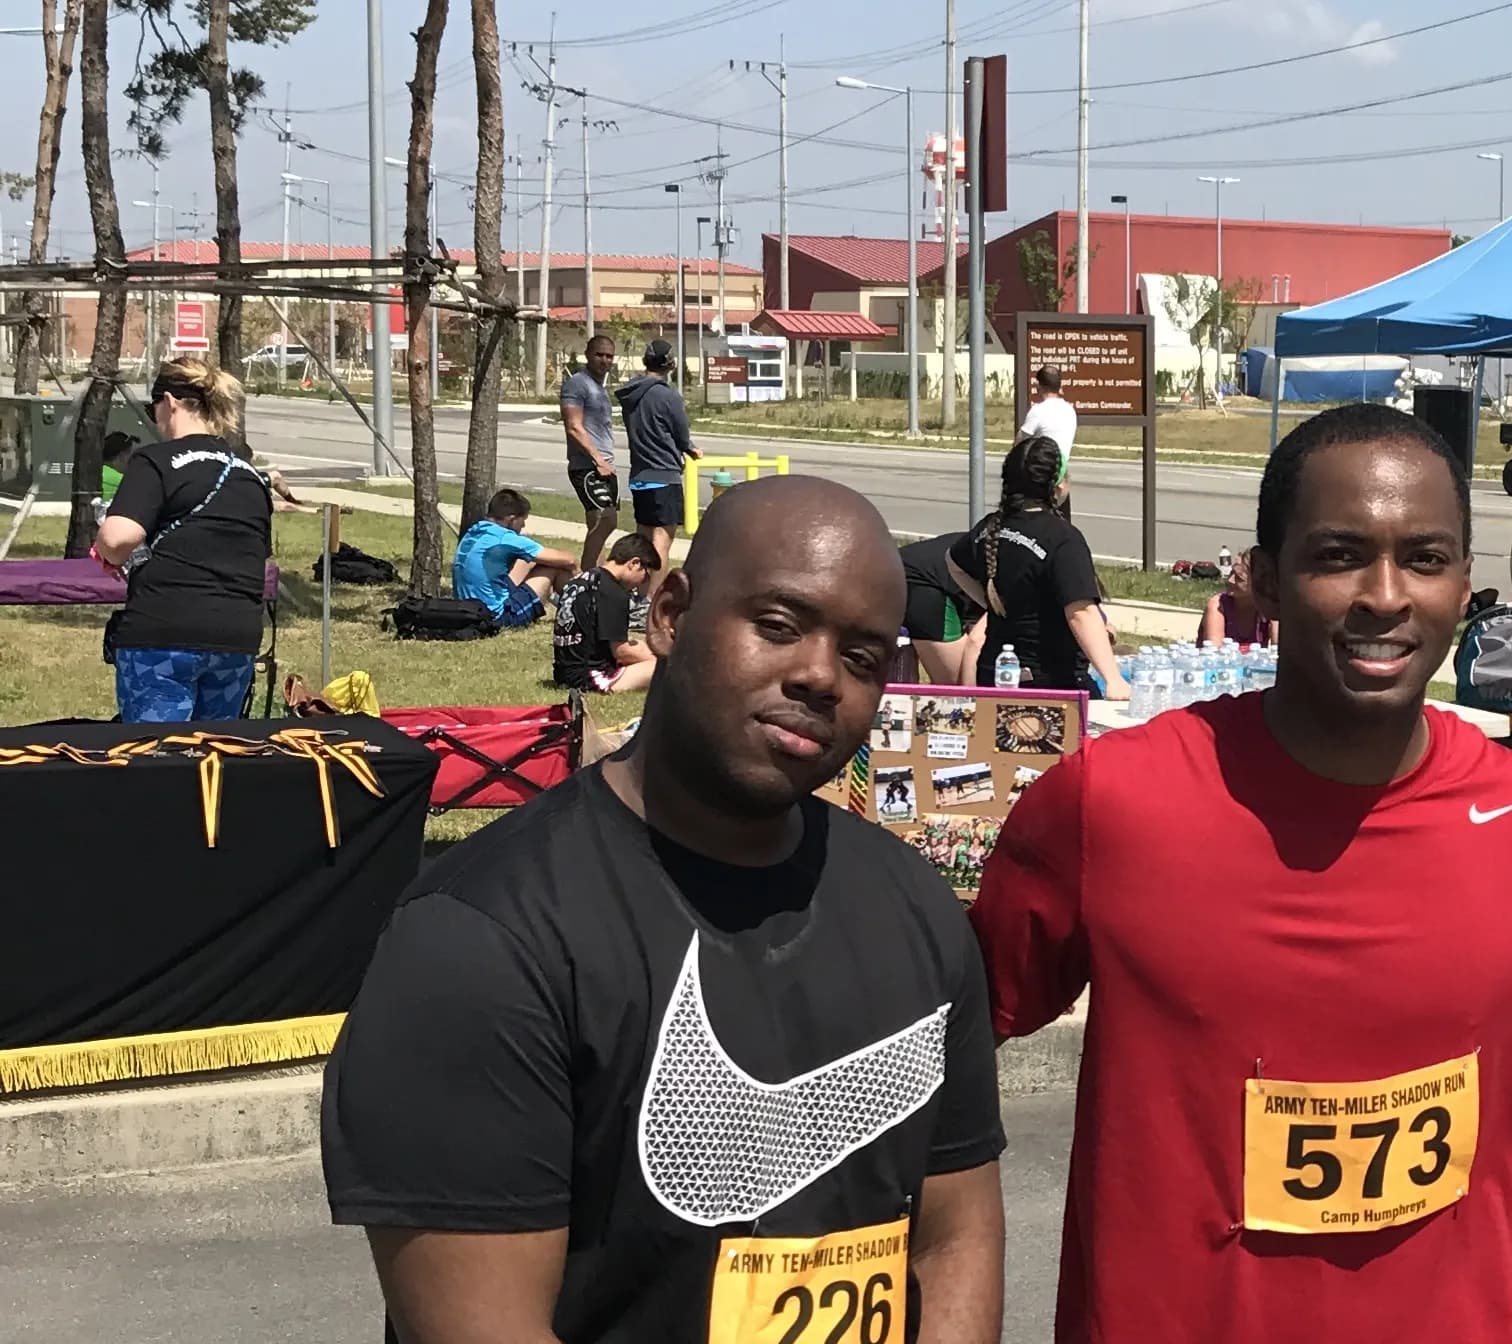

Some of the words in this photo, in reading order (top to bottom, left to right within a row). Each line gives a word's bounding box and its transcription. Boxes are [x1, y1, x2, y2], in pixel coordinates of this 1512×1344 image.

[1264, 1095, 1307, 1116] ARMY
[1310, 1093, 1388, 1116] TEN-MILER
[1391, 1080, 1442, 1109] SHADOW
[1444, 1071, 1465, 1095] RUN
[1282, 1106, 1452, 1201] 573
[1321, 1210, 1360, 1226] Camp
[1364, 1198, 1427, 1223] Humphreys
[730, 1253, 775, 1274] ARMY
[781, 1244, 854, 1273] TEN-MILER
[856, 1235, 900, 1263] SHADOW
